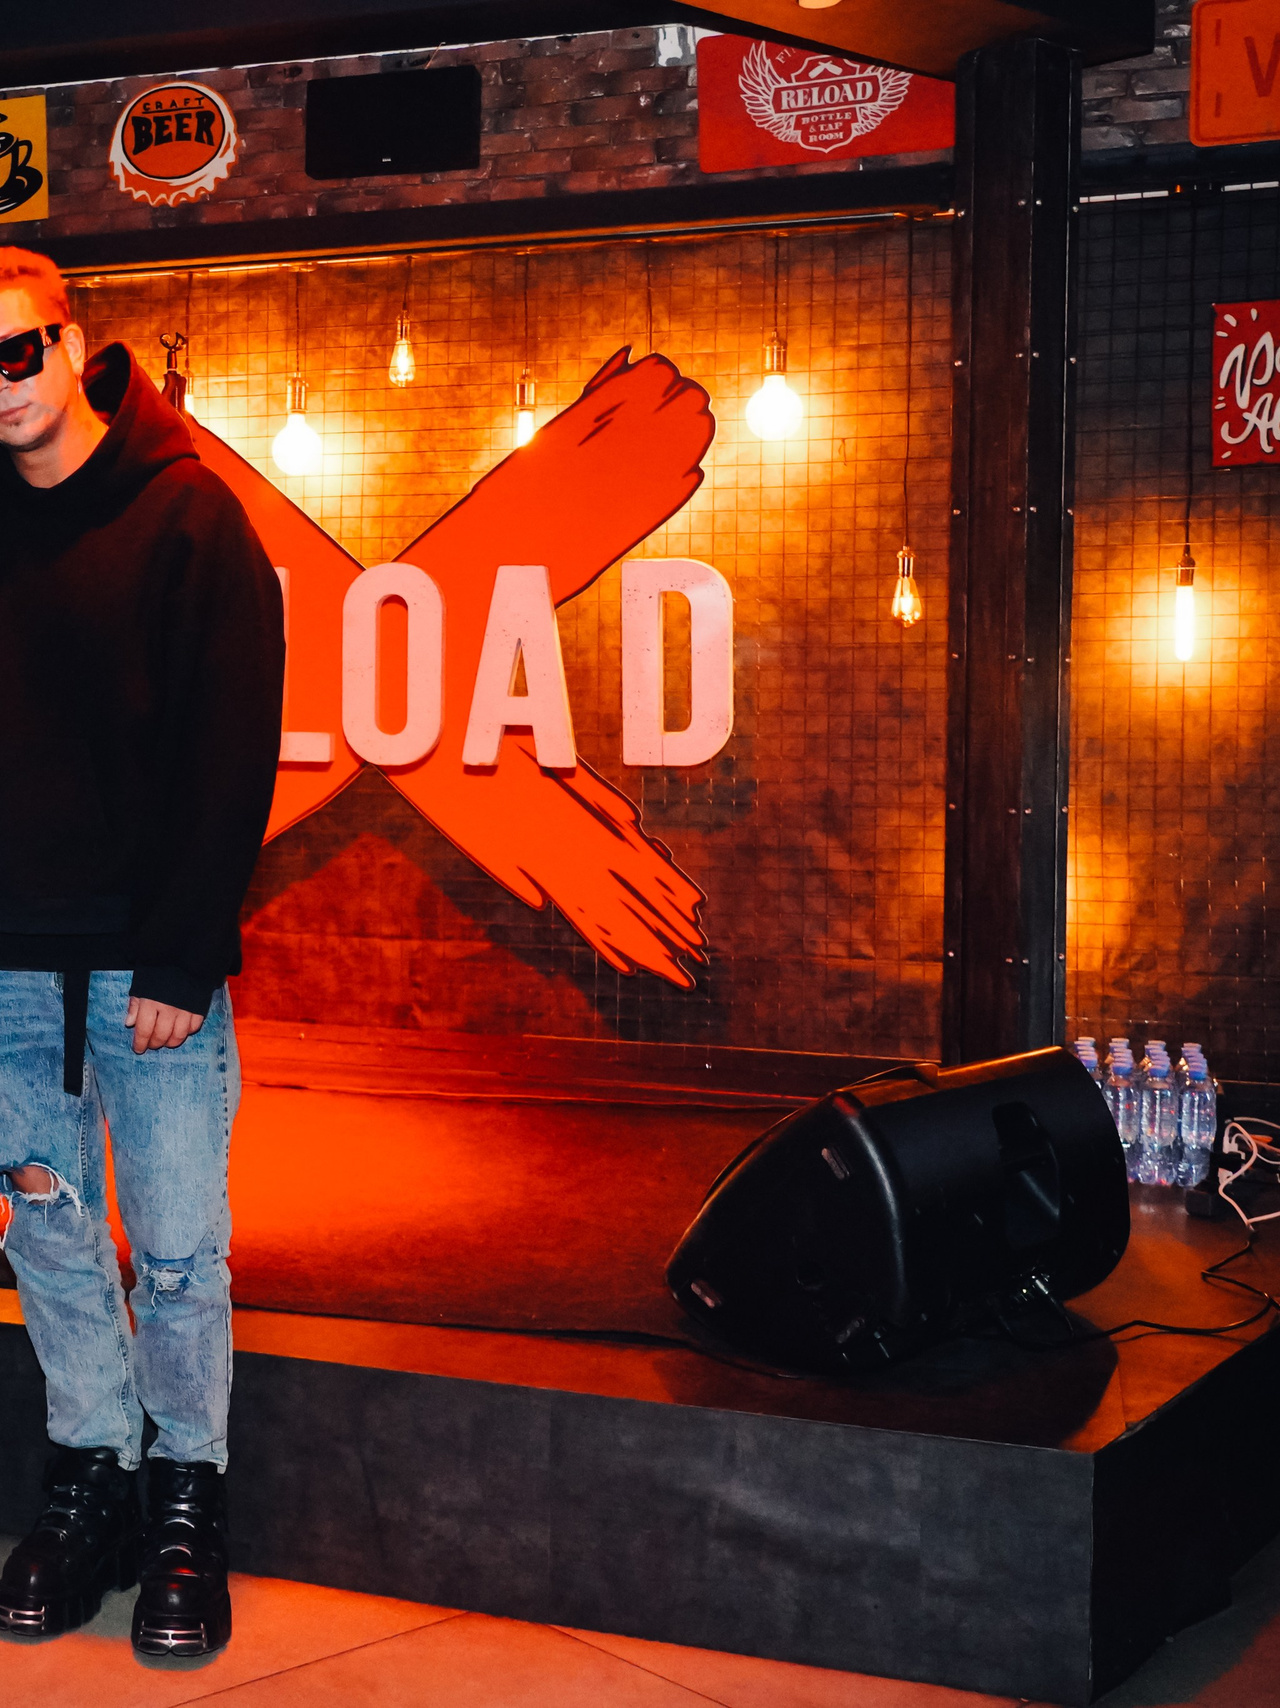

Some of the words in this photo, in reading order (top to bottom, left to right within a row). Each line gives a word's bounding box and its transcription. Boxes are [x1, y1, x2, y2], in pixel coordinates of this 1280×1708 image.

[775, 47, 796, 64] FI
[780, 81, 873, 110] RELOAD
[142, 96, 205, 111] CRAFT
[801, 112, 852, 125] BOTTLE
[131, 110, 215, 155] BEER
[809, 125, 816, 133] &
[818, 122, 843, 131] TAP
[809, 132, 844, 142] ROOM
